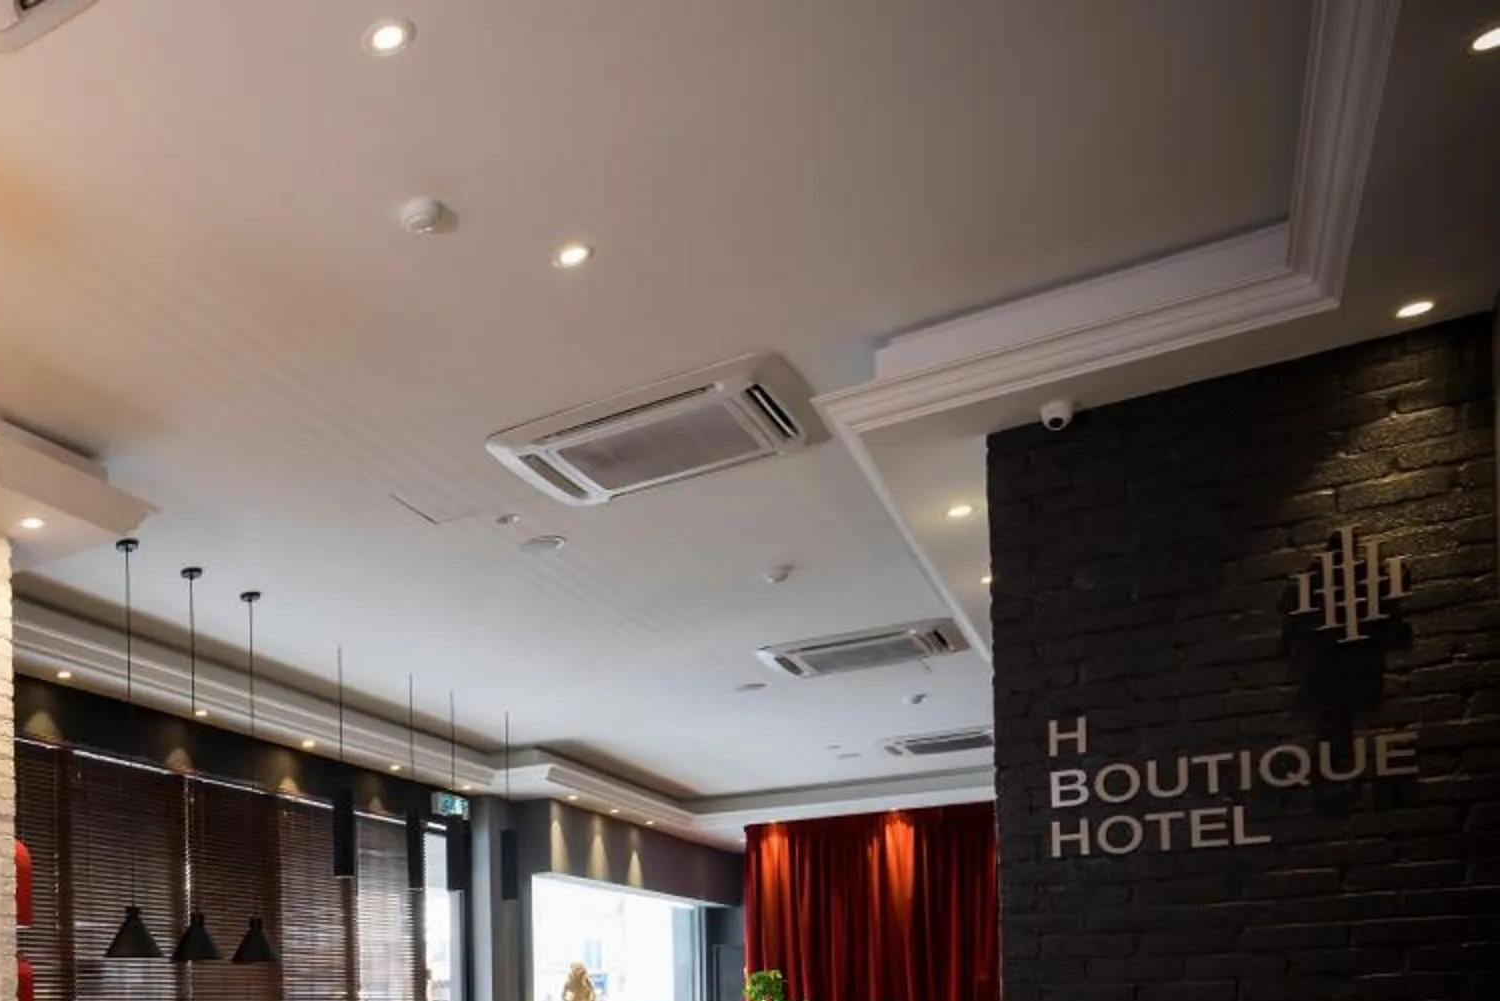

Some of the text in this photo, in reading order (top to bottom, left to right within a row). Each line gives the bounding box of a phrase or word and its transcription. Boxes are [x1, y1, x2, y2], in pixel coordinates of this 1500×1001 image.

[1048, 716, 1087, 758] H
[1049, 731, 1420, 809] BOUTIQUE
[1051, 805, 1272, 859] HOTEL
